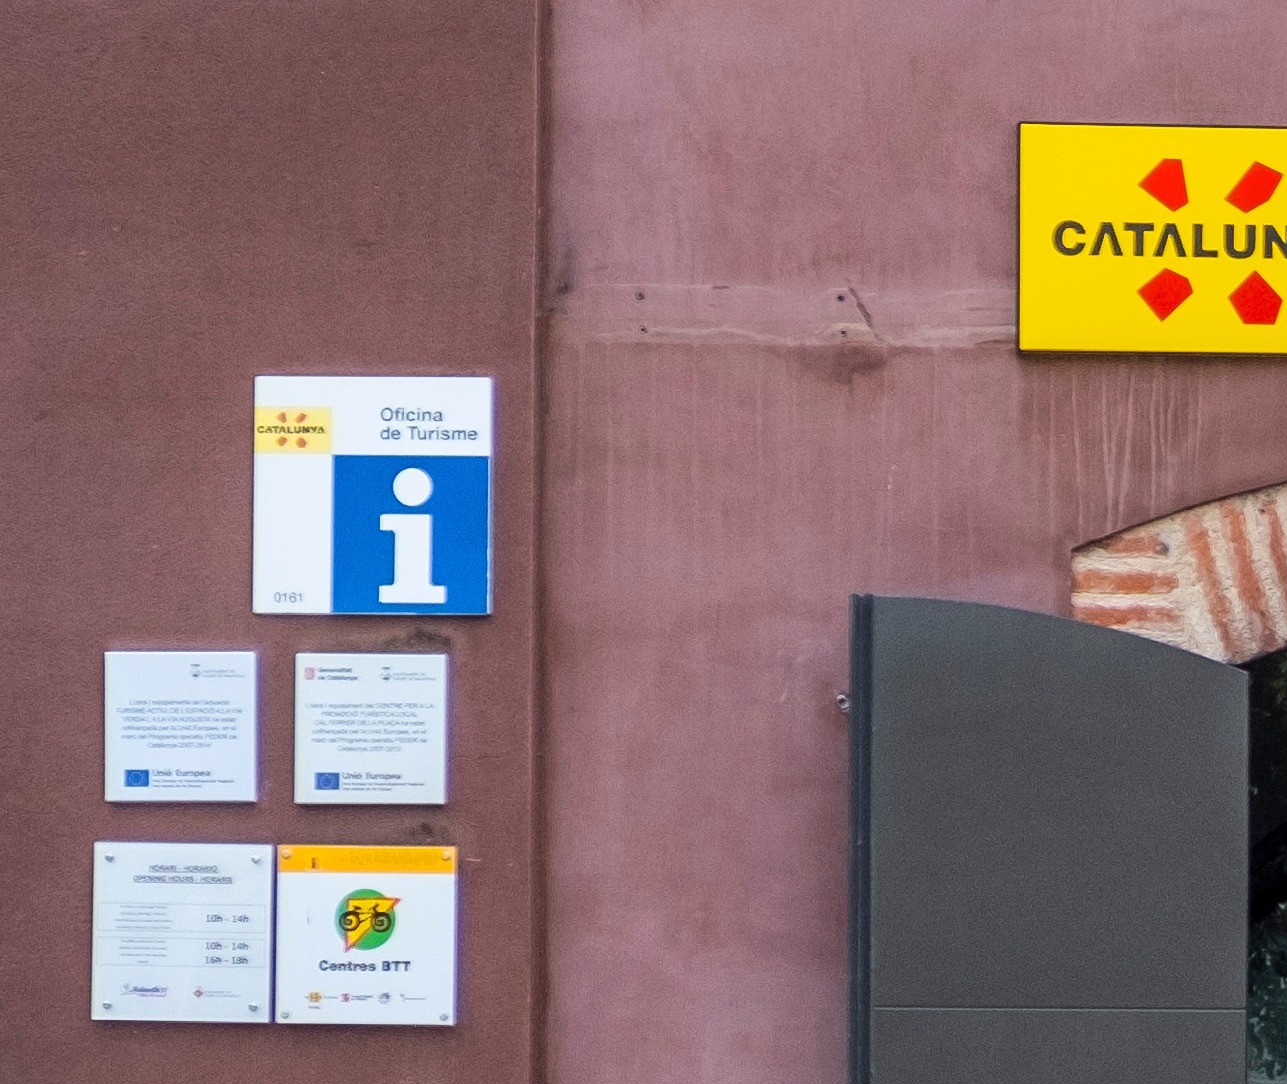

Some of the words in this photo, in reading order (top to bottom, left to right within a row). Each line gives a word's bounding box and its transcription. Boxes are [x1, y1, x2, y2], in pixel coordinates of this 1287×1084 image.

[380, 407, 443, 423] Oficina
[256, 425, 327, 435] CATALUNYA
[380, 426, 400, 440] de
[409, 426, 479, 441] Turisme
[378, 467, 447, 604] i
[274, 592, 304, 603] 0161
[206, 914, 223, 923] 10h
[232, 915, 249, 923] 14h
[205, 941, 222, 951] 10h
[318, 960, 376, 972] Centres
[381, 961, 411, 972] BTT
